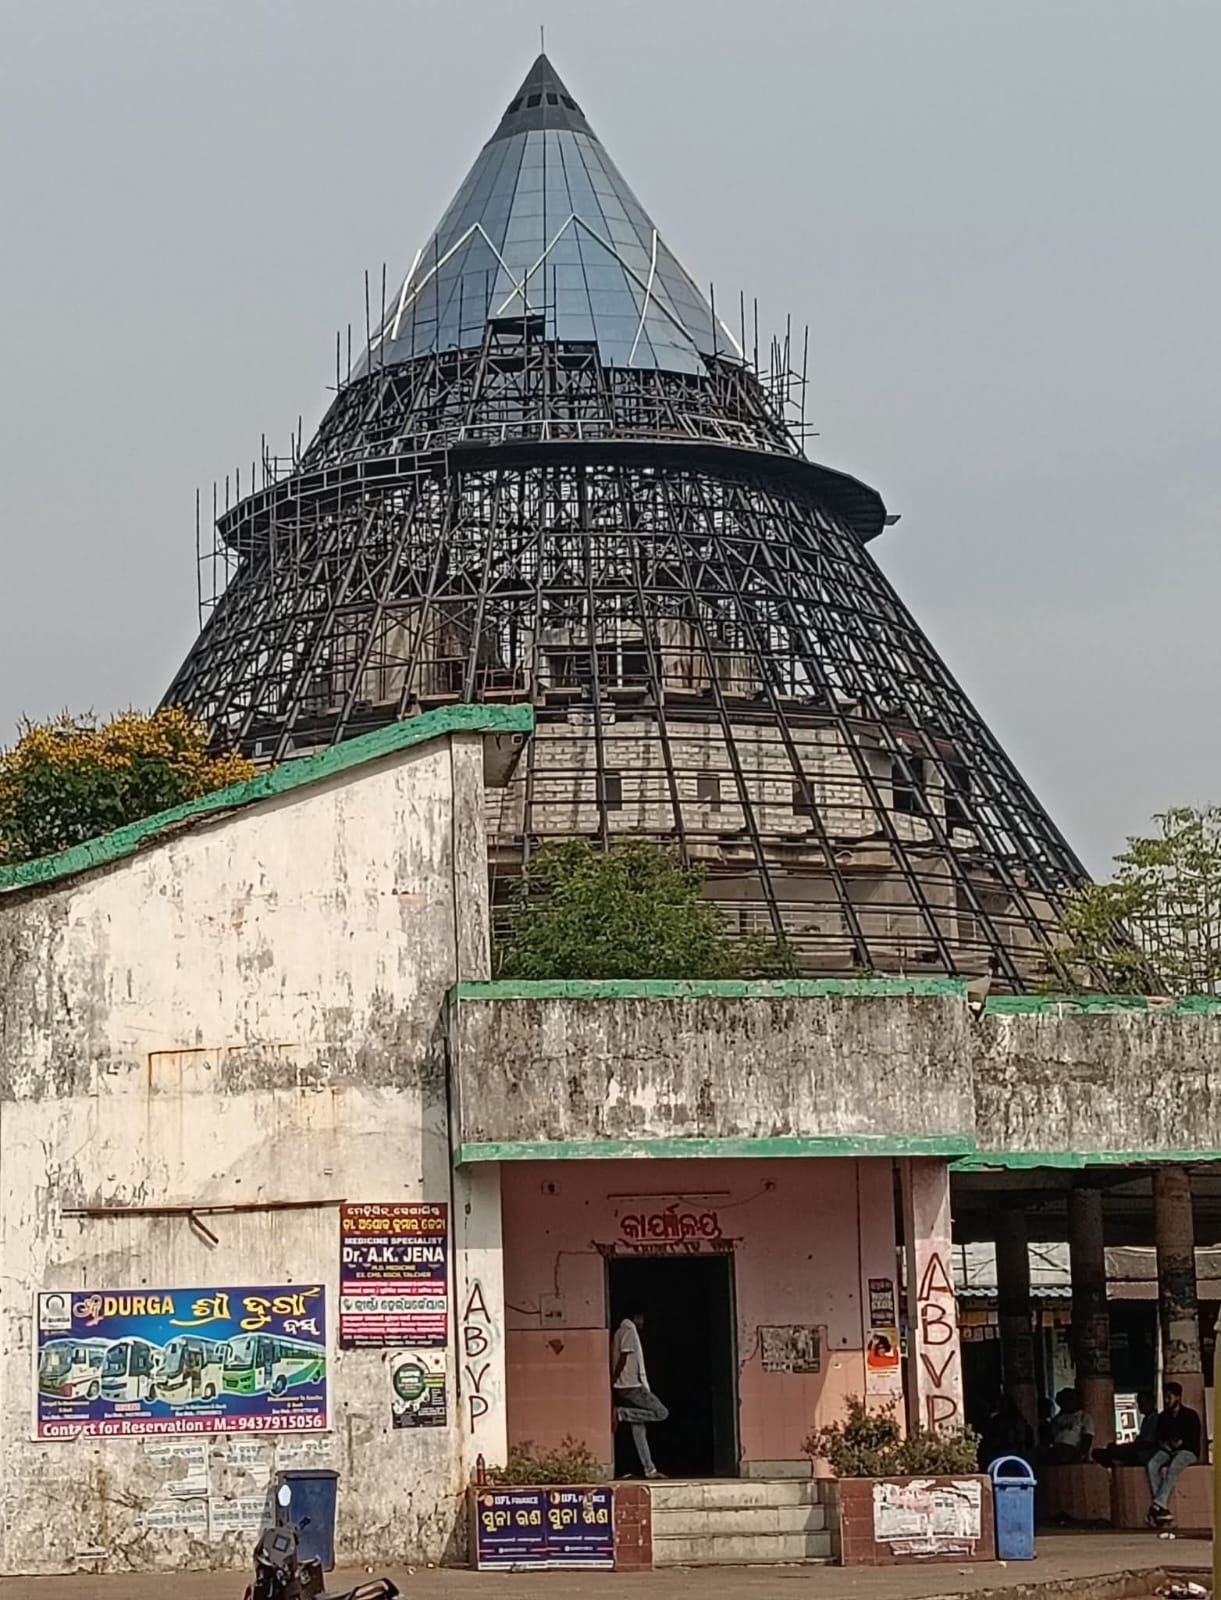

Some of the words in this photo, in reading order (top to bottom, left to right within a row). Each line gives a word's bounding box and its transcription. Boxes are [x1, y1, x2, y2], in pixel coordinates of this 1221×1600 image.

[391, 1237, 443, 1245] SPECIALIST
[343, 1246, 363, 1263] Dr.
[367, 1246, 398, 1263] A.K.
[402, 1246, 445, 1263] JENA
[104, 1296, 174, 1316] DURGA
[98, 1420, 120, 1435] for
[121, 1418, 204, 1434] Reservation
[238, 1415, 323, 1430] 9437915056
[481, 1510, 511, 1532] ସୁନା
[547, 1508, 578, 1530] ସୁନା
